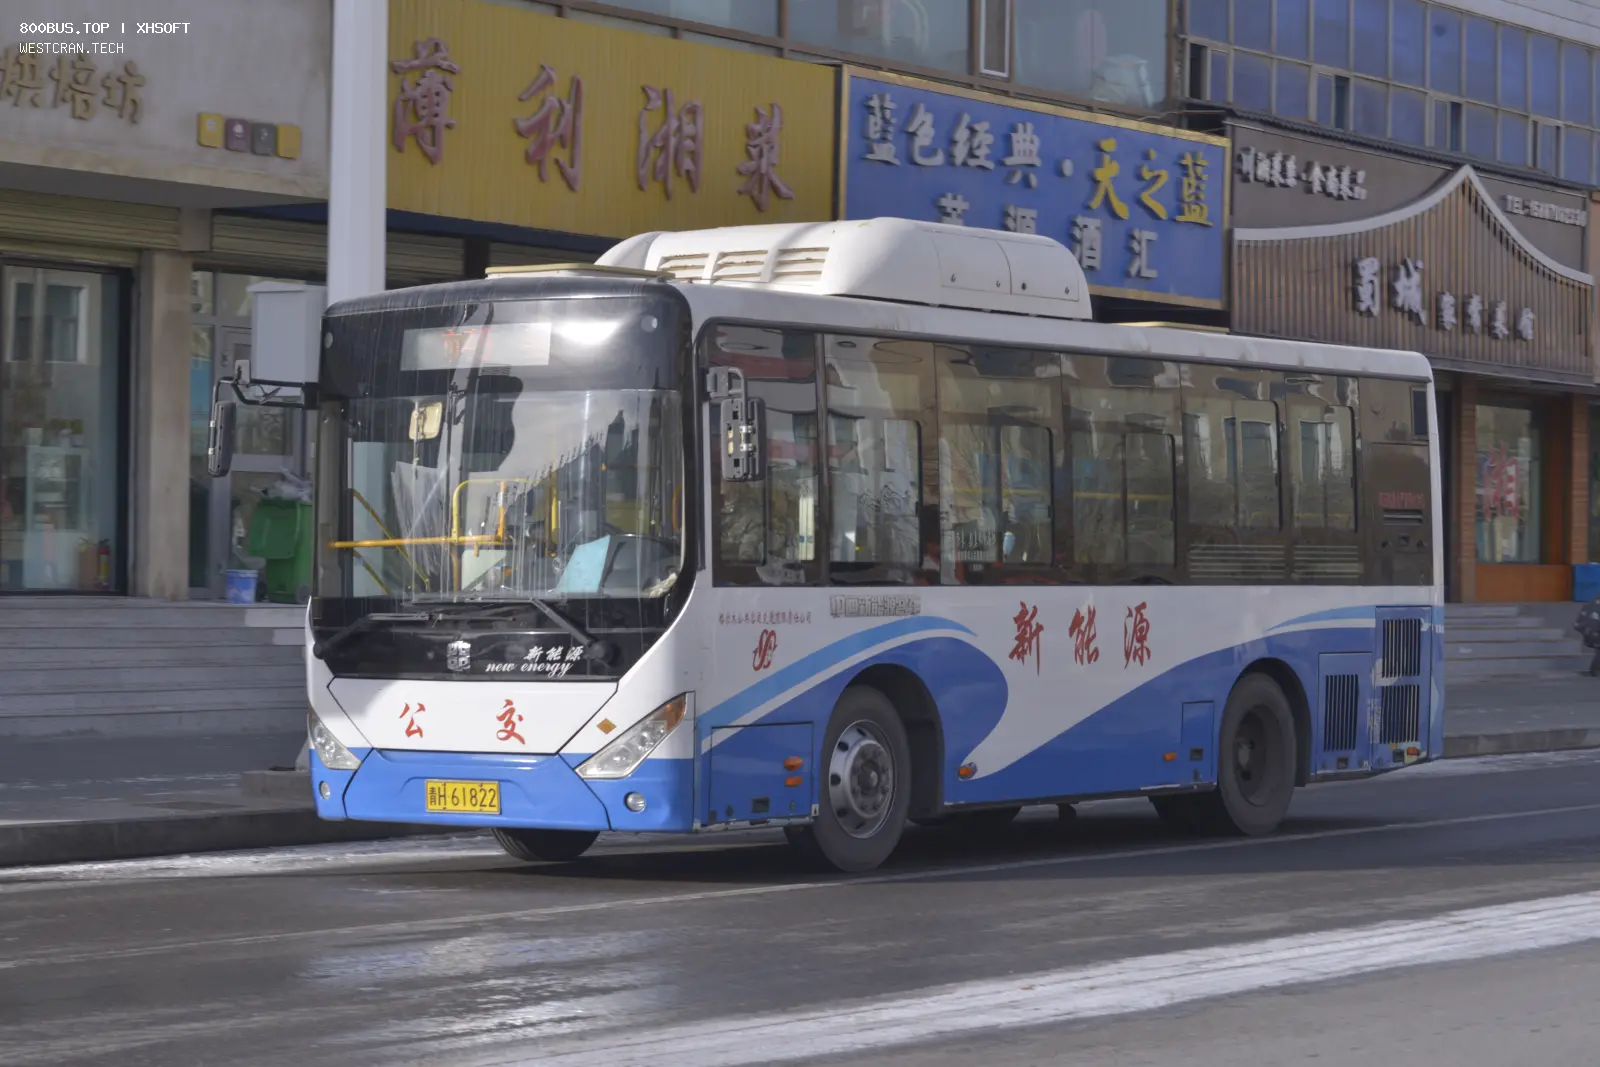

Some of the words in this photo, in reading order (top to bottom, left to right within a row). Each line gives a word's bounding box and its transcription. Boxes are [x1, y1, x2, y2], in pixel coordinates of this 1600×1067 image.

[390, 36, 795, 213] 薄利湘菜
[523, 645, 584, 662] 新能源
[1008, 600, 1151, 676] 新能源
[485, 662, 516, 672] new
[520, 662, 573, 679] energy
[399, 698, 527, 745] 公交
